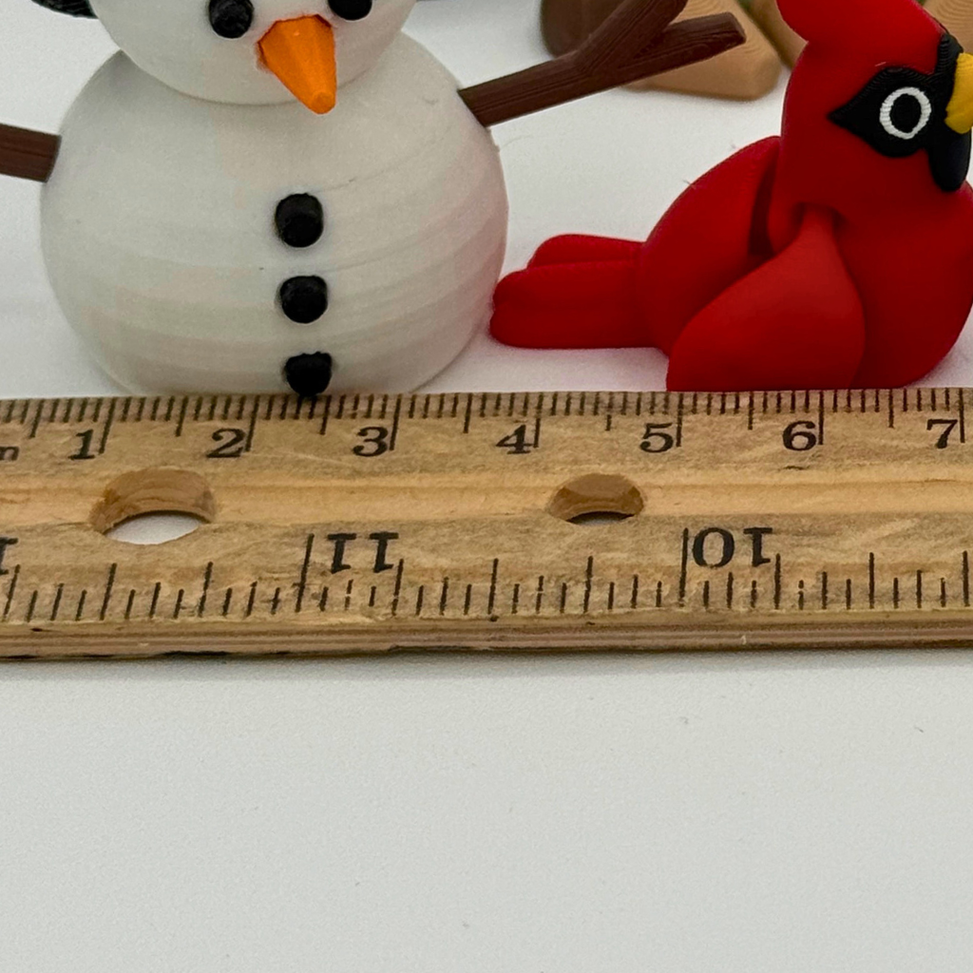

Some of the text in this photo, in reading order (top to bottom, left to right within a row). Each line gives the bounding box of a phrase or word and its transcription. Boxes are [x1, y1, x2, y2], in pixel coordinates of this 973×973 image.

[68, 429, 96, 461] 1
[206, 427, 247, 458] 2
[352, 426, 389, 457] 3
[496, 424, 533, 455] 4
[639, 422, 675, 454] 5
[781, 420, 818, 451] 6
[926, 418, 958, 449] 7
[326, 532, 399, 573] 11
[692, 527, 773, 568] 10
